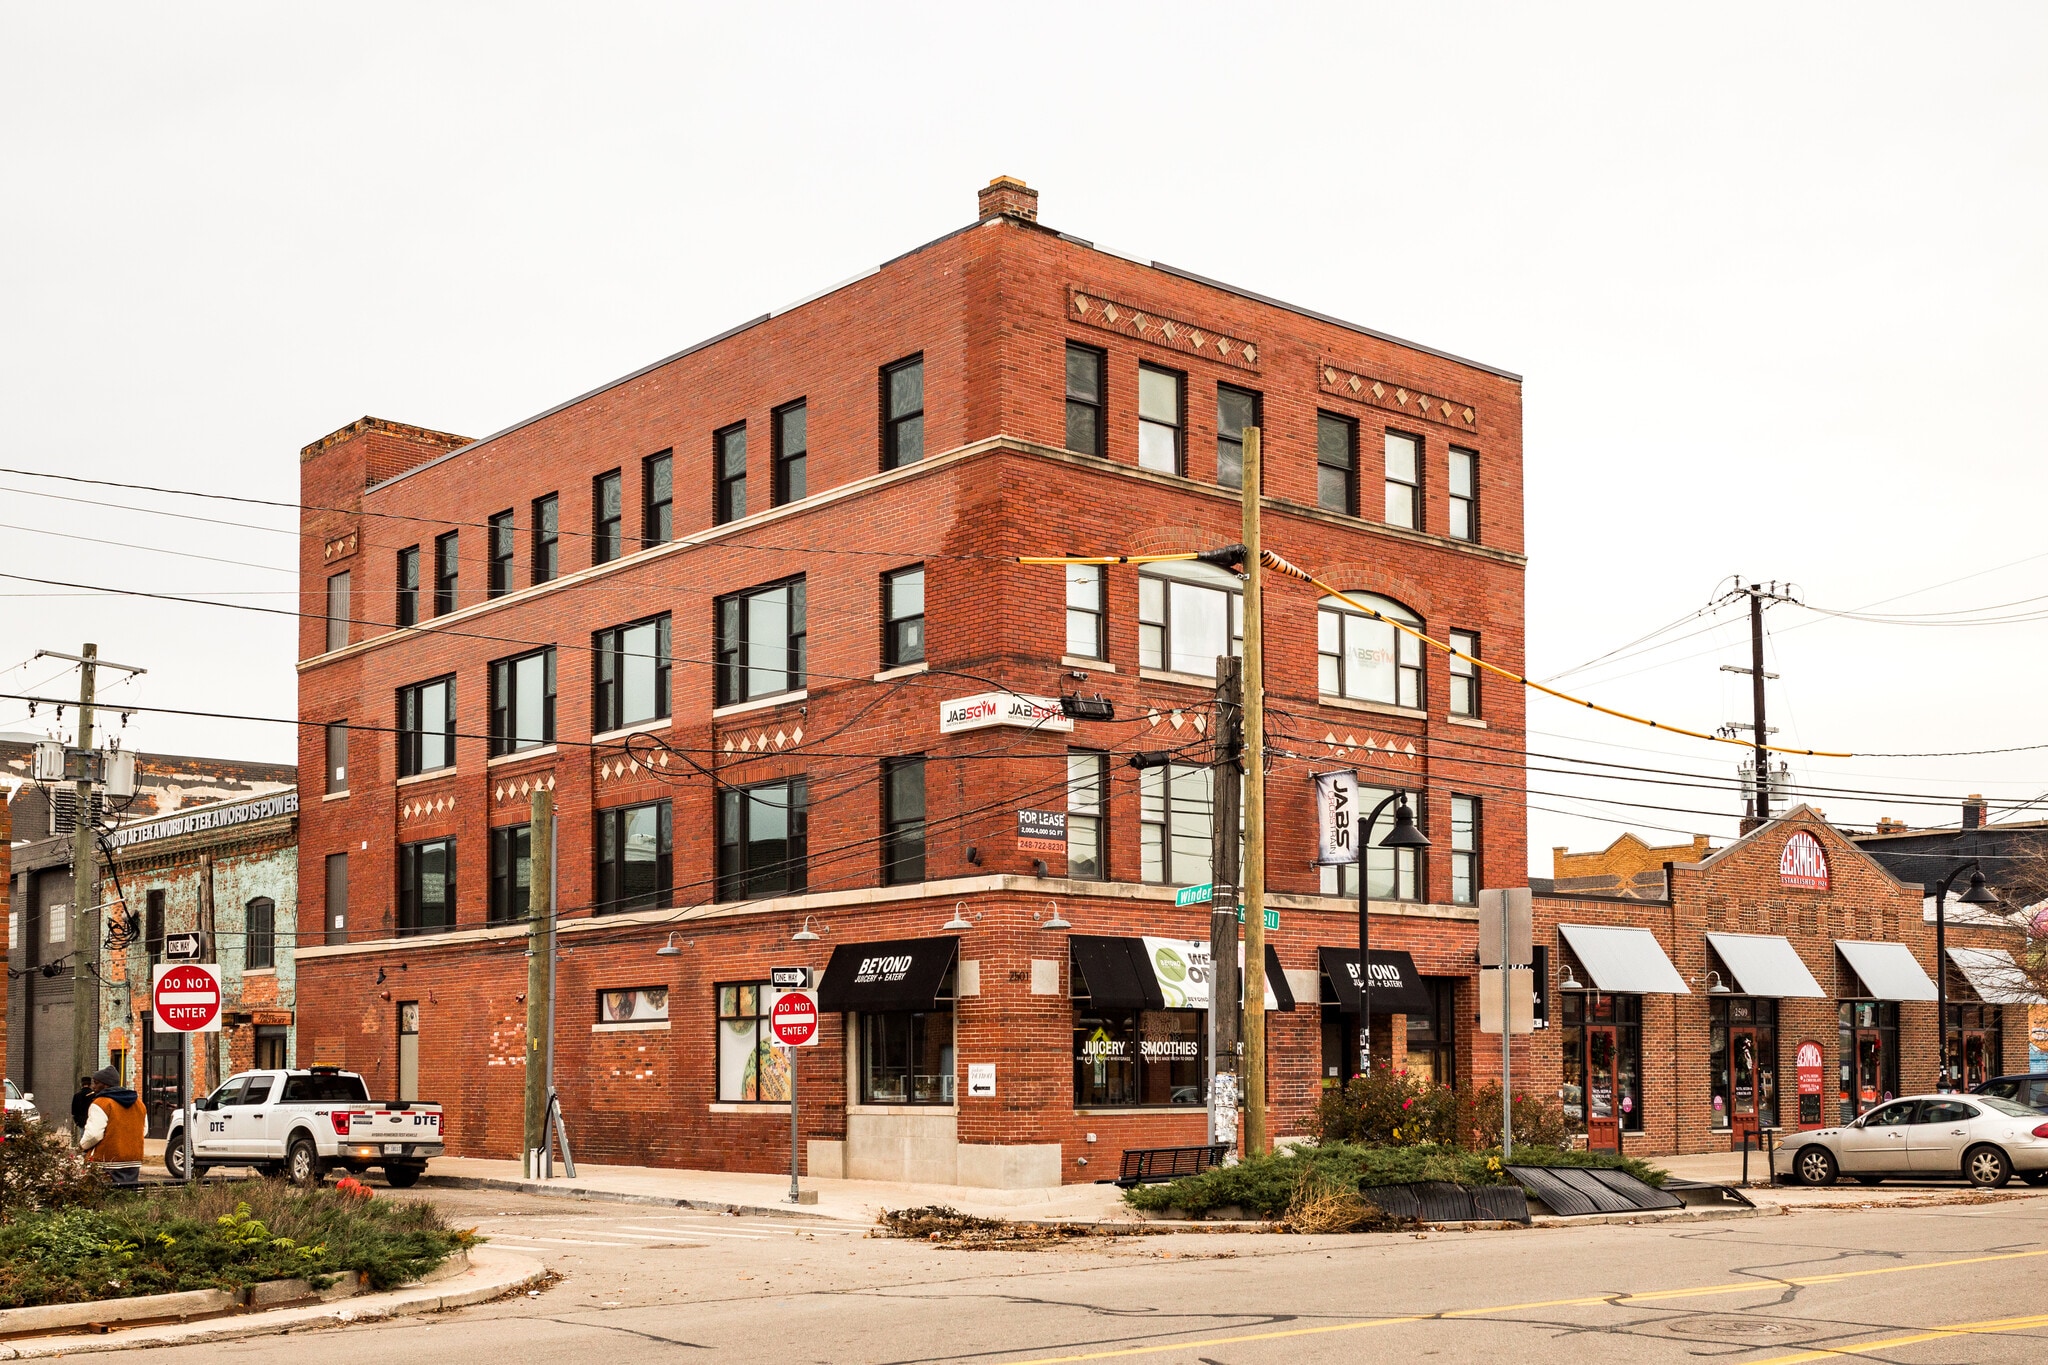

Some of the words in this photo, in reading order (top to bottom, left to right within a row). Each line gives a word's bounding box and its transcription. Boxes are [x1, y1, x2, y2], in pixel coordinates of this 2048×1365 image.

[946, 700, 996, 723] JABSGYM
[127, 823, 153, 845] AFTER
[153, 825, 160, 840] A
[160, 820, 183, 839] WORD
[183, 815, 212, 833] AFTER
[212, 811, 219, 827] A
[218, 804, 249, 826] WORD
[248, 801, 261, 821] IS
[260, 793, 299, 818] POWER
[1020, 811, 1037, 824] FOR
[1039, 813, 1064, 827] LEASE
[1333, 779, 1350, 851] JABS
[1780, 833, 1828, 878] GERMACK
[1782, 877, 1816, 886] ESTABLISHED
[1180, 887, 1212, 904] Winder
[1240, 907, 1275, 927] Rell
[170, 942, 178, 952] ONE
[180, 941, 190, 952] WAY
[858, 956, 912, 974] BEYOND
[164, 978, 180, 988] DO
[186, 978, 210, 988] NOT
[776, 974, 786, 982] ONE
[854, 974, 878, 982] JUICERY
[884, 972, 906, 981] EATERY
[170, 1008, 206, 1018] ENTER
[778, 1004, 790, 1012] DO
[794, 1002, 810, 1012] NOT
[782, 1026, 808, 1036] ENTER
[1082, 1040, 1126, 1055] JUICERY
[1141, 1042, 1198, 1056] SMOOTHIES
[210, 1122, 224, 1132] DTE
[414, 1116, 437, 1126] DTE
